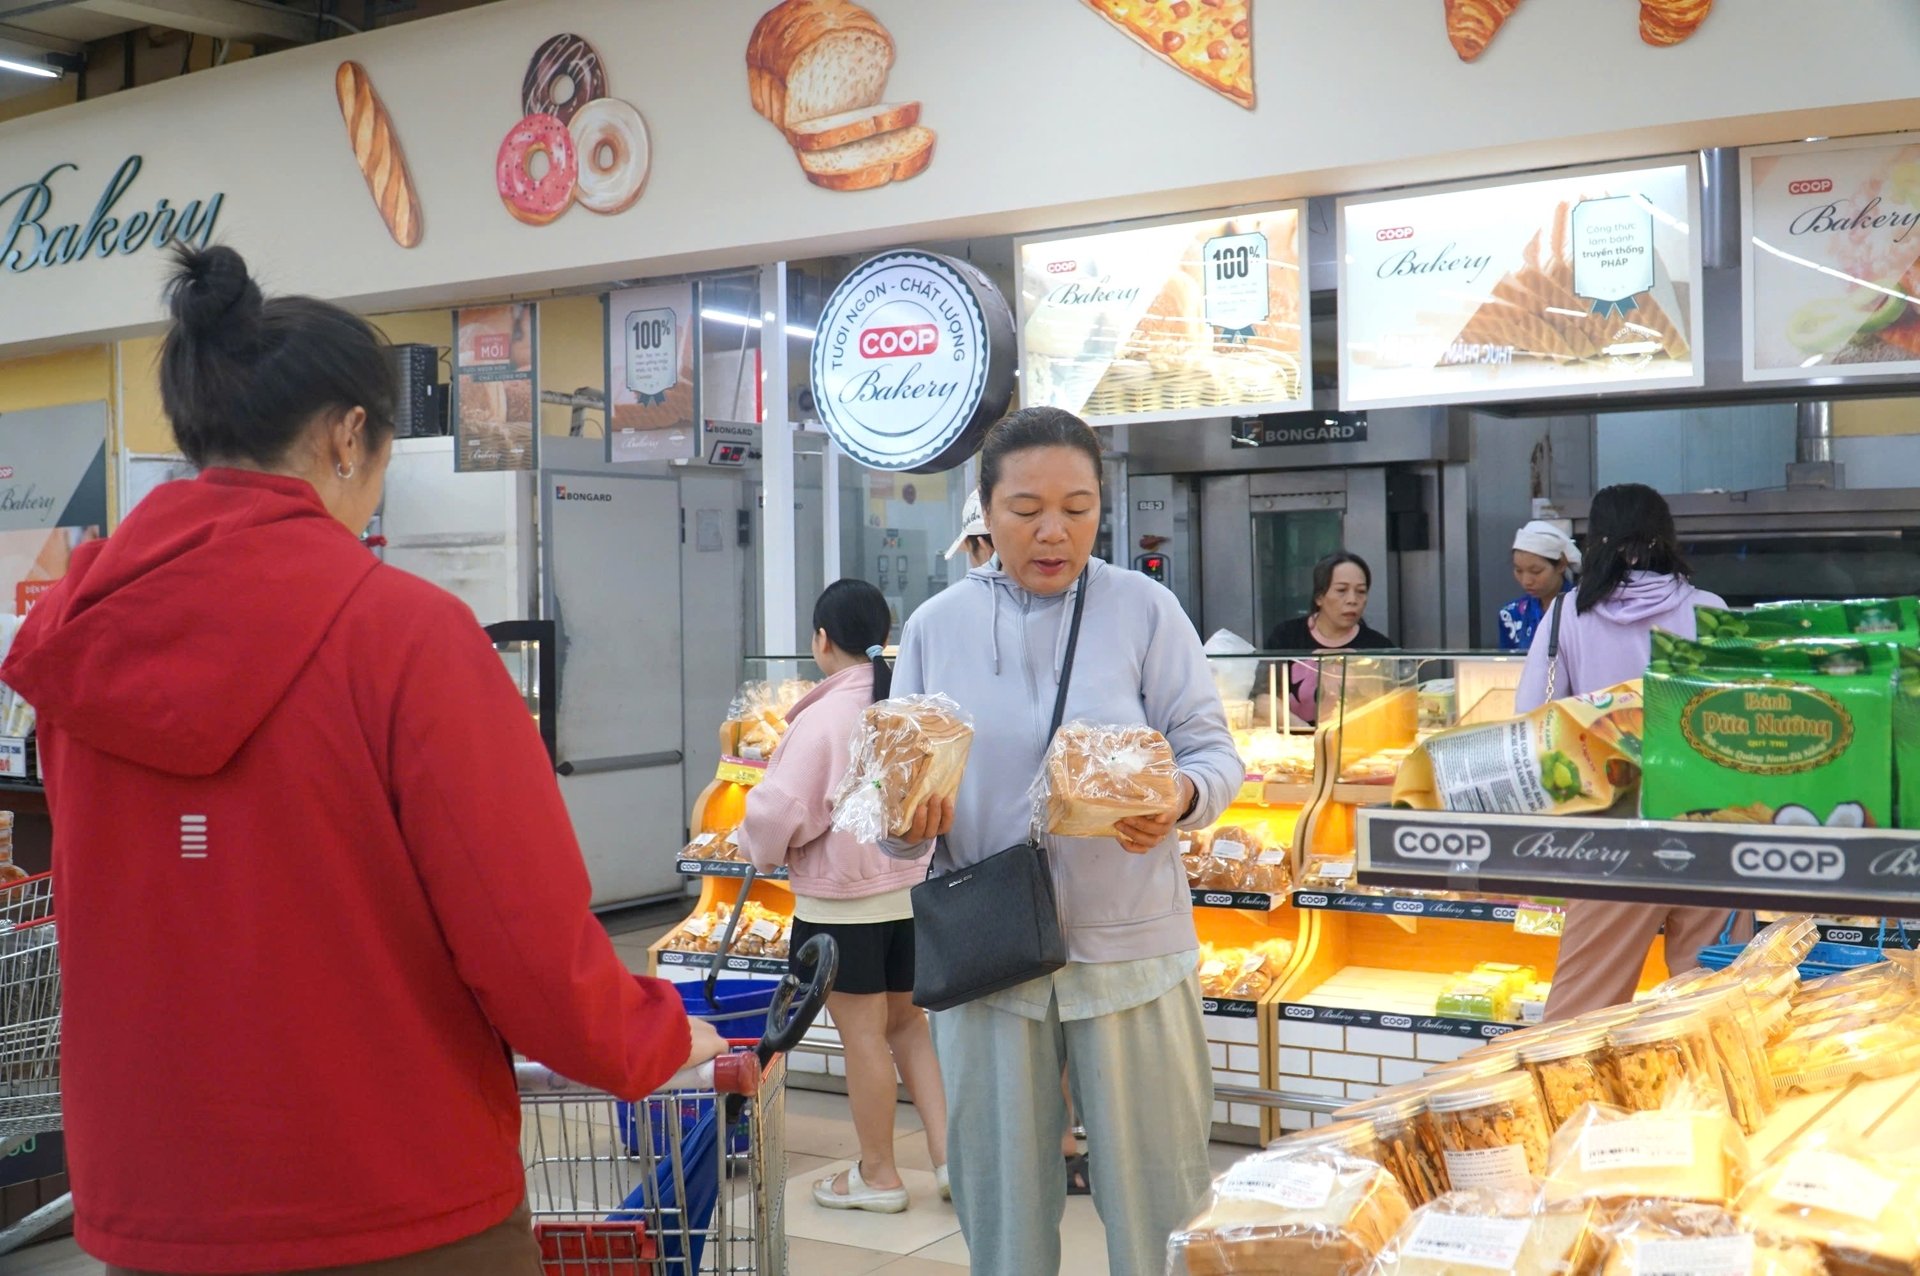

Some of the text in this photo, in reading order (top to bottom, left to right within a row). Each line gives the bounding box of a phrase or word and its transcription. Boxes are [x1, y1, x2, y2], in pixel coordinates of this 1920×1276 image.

[1790, 181, 1831, 194] COOP
[0, 155, 224, 273] Bakery
[1789, 197, 1920, 242] Bakery
[1377, 227, 1413, 241] COOP
[1047, 261, 1076, 273] COOP
[1213, 245, 1260, 280] 100%
[1377, 242, 1492, 283] Bakery
[1047, 275, 1140, 307] Bakery
[632, 319, 671, 351] 100%
[832, 326, 850, 370] TƯƠI
[846, 281, 887, 324] NGON
[900, 277, 941, 303] CHẤT
[937, 298, 966, 362] LƯỢNG
[862, 328, 936, 355] COOP
[838, 361, 959, 404] Bakery
[714, 425, 753, 436] BONGARD
[1265, 425, 1355, 443] BONGARD
[566, 492, 613, 502] BONGARD
[1399, 831, 1486, 856] COOP
[1512, 829, 1631, 877] Bakery
[1738, 848, 1840, 874] COOP
[681, 863, 700, 871] COOP
[1206, 895, 1232, 904] COOP
[1300, 895, 1327, 904] COOP
[1394, 901, 1423, 911] COOP
[1429, 902, 1465, 917] Bakery
[1494, 909, 1515, 918] COO
[1829, 930, 1861, 941] COOP
[663, 953, 683, 963] COOP
[729, 959, 749, 968] COOP
[1286, 1007, 1314, 1016] COOP
[1382, 1016, 1411, 1026] COOP
